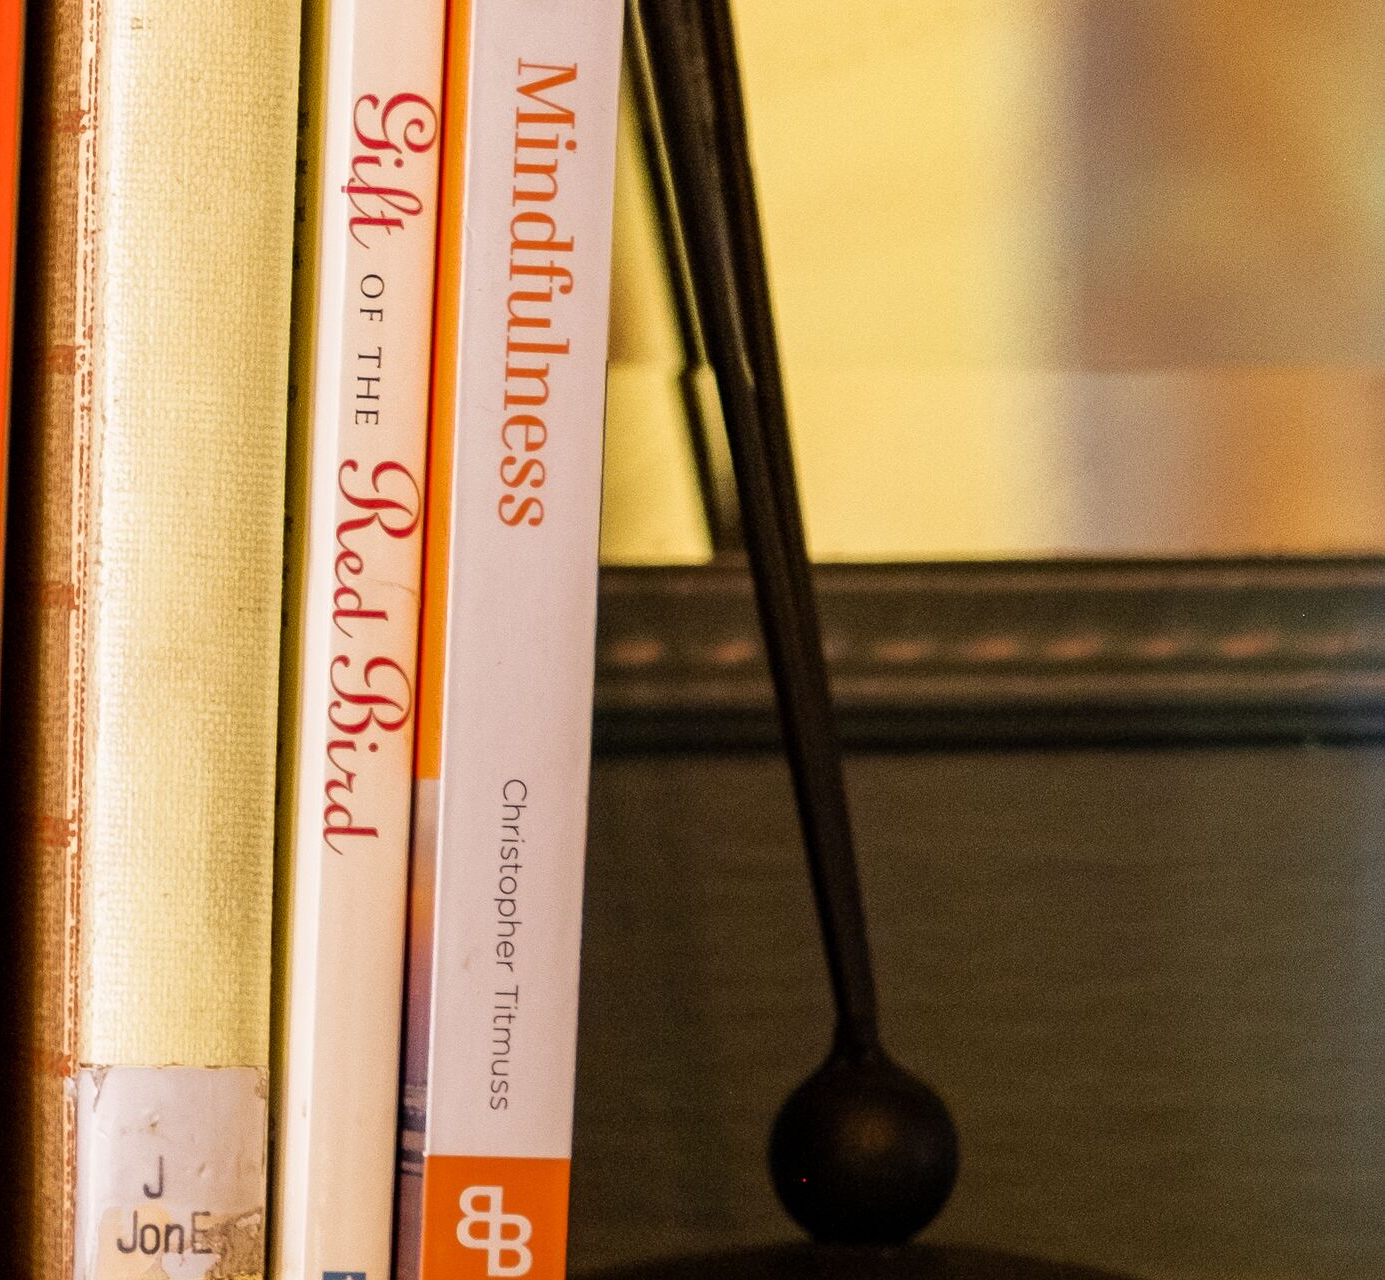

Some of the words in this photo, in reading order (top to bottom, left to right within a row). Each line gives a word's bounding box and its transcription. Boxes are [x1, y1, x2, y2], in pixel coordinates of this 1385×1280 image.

[341, 92, 437, 249] Gift
[360, 274, 384, 322] OF
[499, 59, 577, 526] Mindfulness
[355, 347, 382, 425] THE
[331, 459, 420, 639] Red
[322, 655, 415, 855] Bird
[494, 779, 527, 972] Christopher
[490, 985, 519, 1110] Titmuss
[143, 1157, 164, 1199] J
